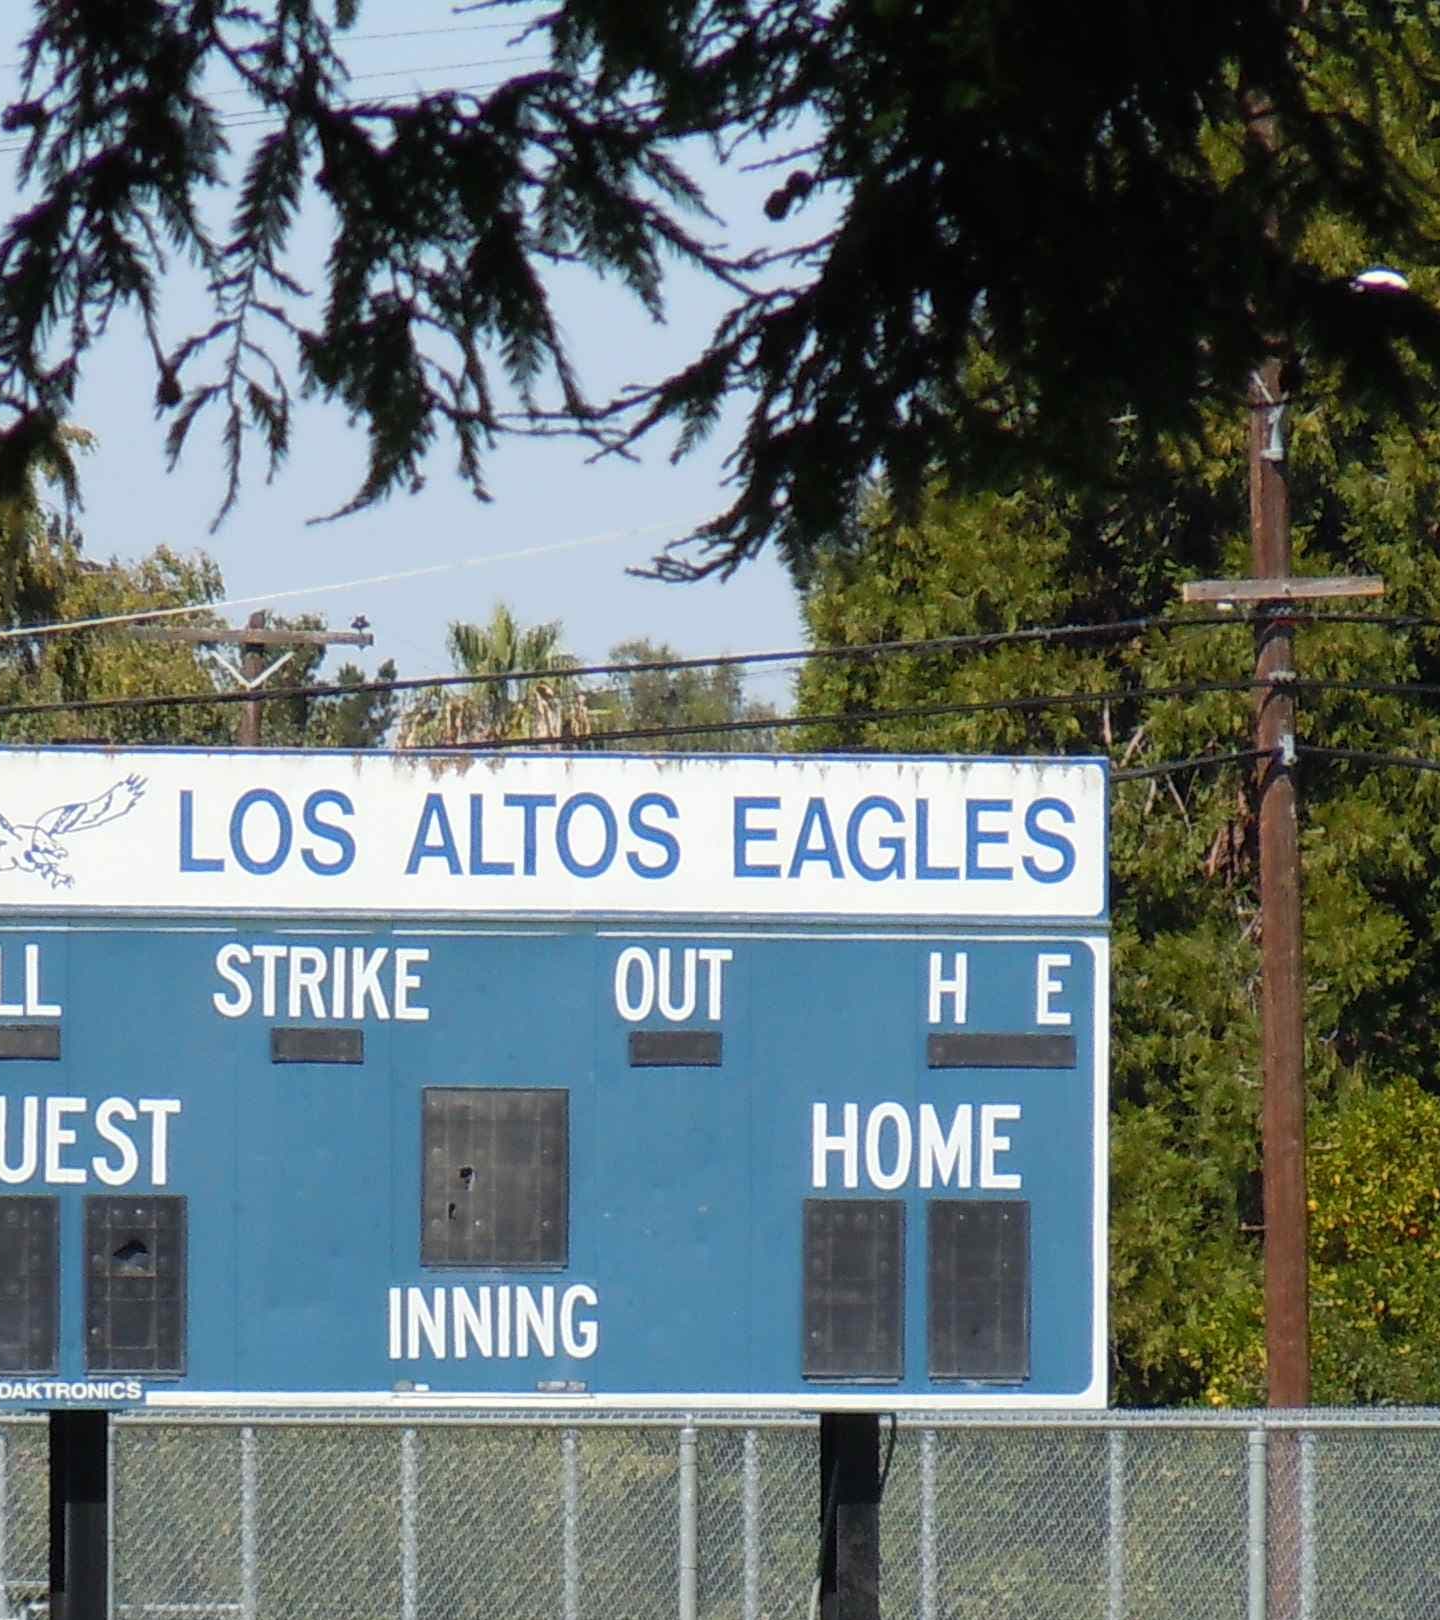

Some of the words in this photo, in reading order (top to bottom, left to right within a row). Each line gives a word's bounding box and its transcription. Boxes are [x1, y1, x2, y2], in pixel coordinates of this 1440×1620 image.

[179, 789, 357, 875] LOS
[405, 792, 681, 880] ALTOS
[732, 795, 1077, 883] EAGLES
[214, 944, 429, 1020] STRIKE
[615, 947, 732, 1021] OUT
[929, 953, 966, 1023] H
[1037, 954, 1070, 1024] E
[813, 1103, 1021, 1189] HOME
[390, 1285, 597, 1359] INNING
